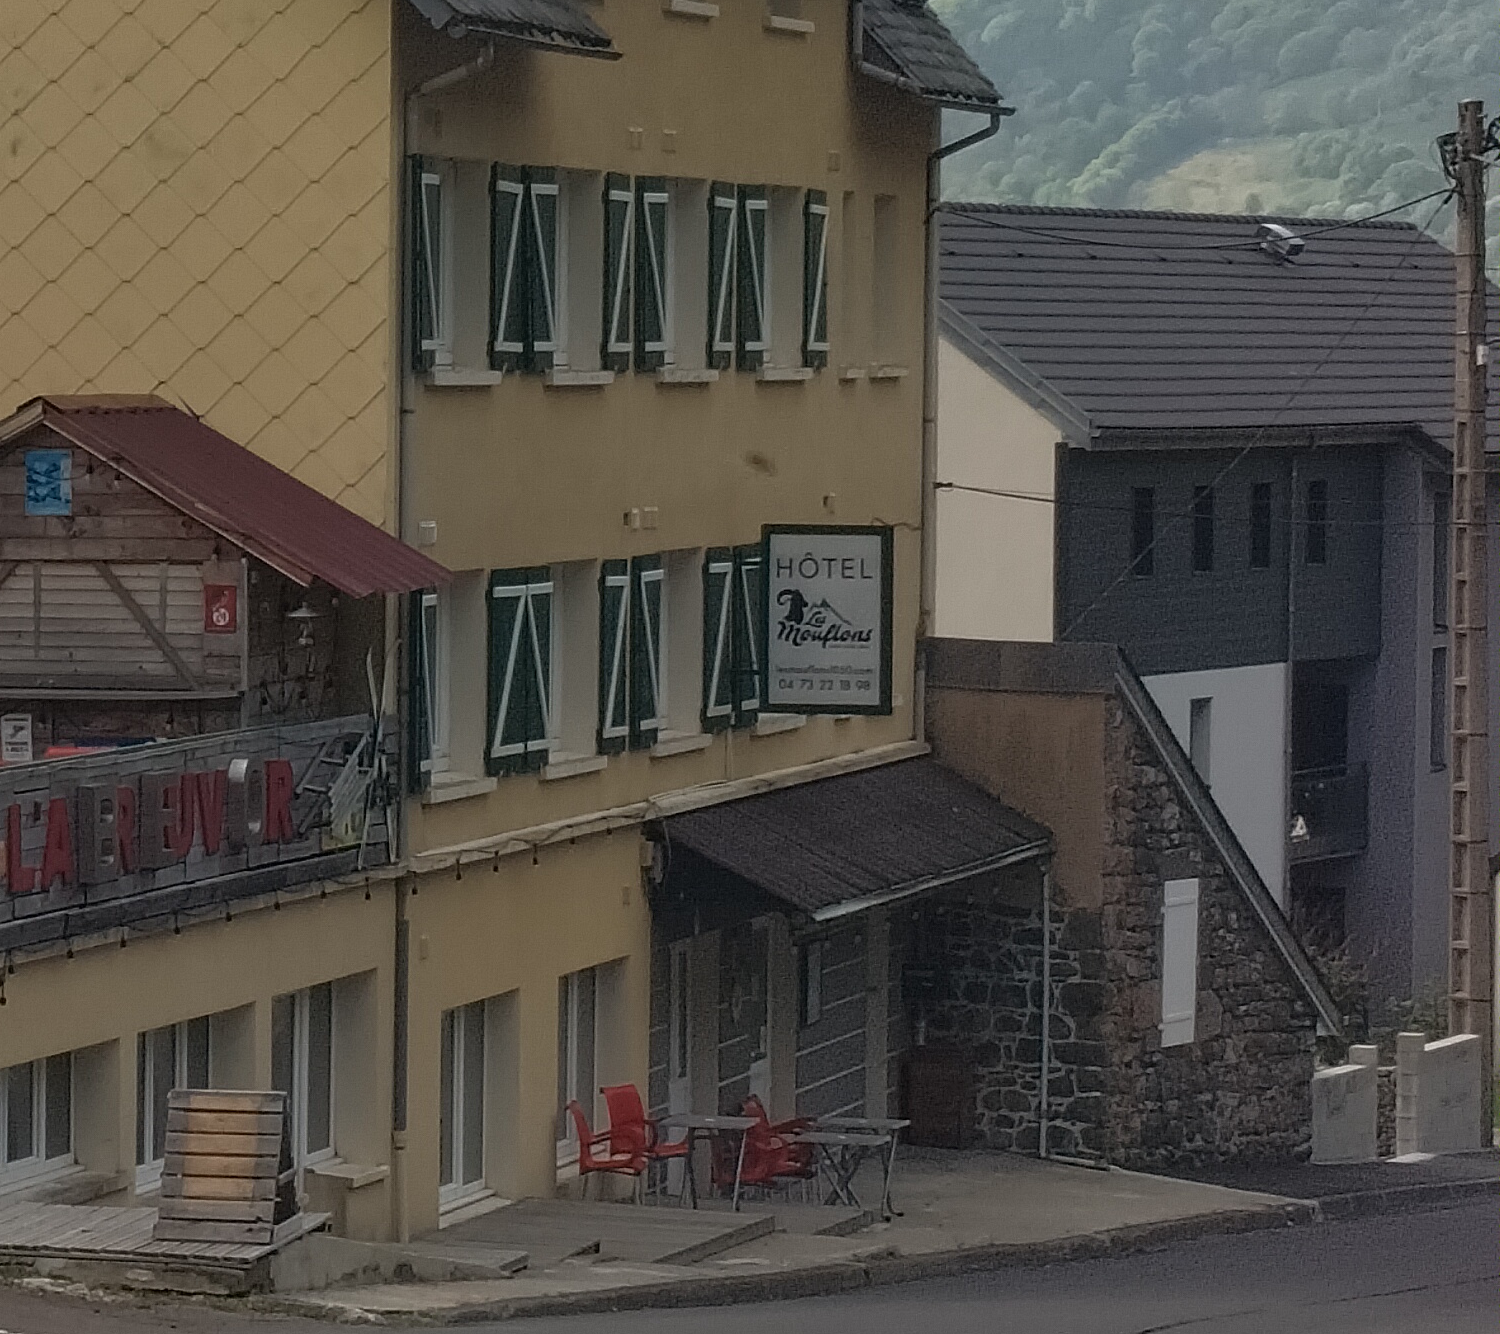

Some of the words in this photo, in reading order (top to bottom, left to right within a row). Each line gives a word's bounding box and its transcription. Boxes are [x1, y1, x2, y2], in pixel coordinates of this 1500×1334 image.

[776, 552, 873, 579] HÔTEL
[804, 611, 827, 627] Les
[777, 622, 873, 648] Mouflons
[7, 758, 294, 893] L'ABREUVOR
